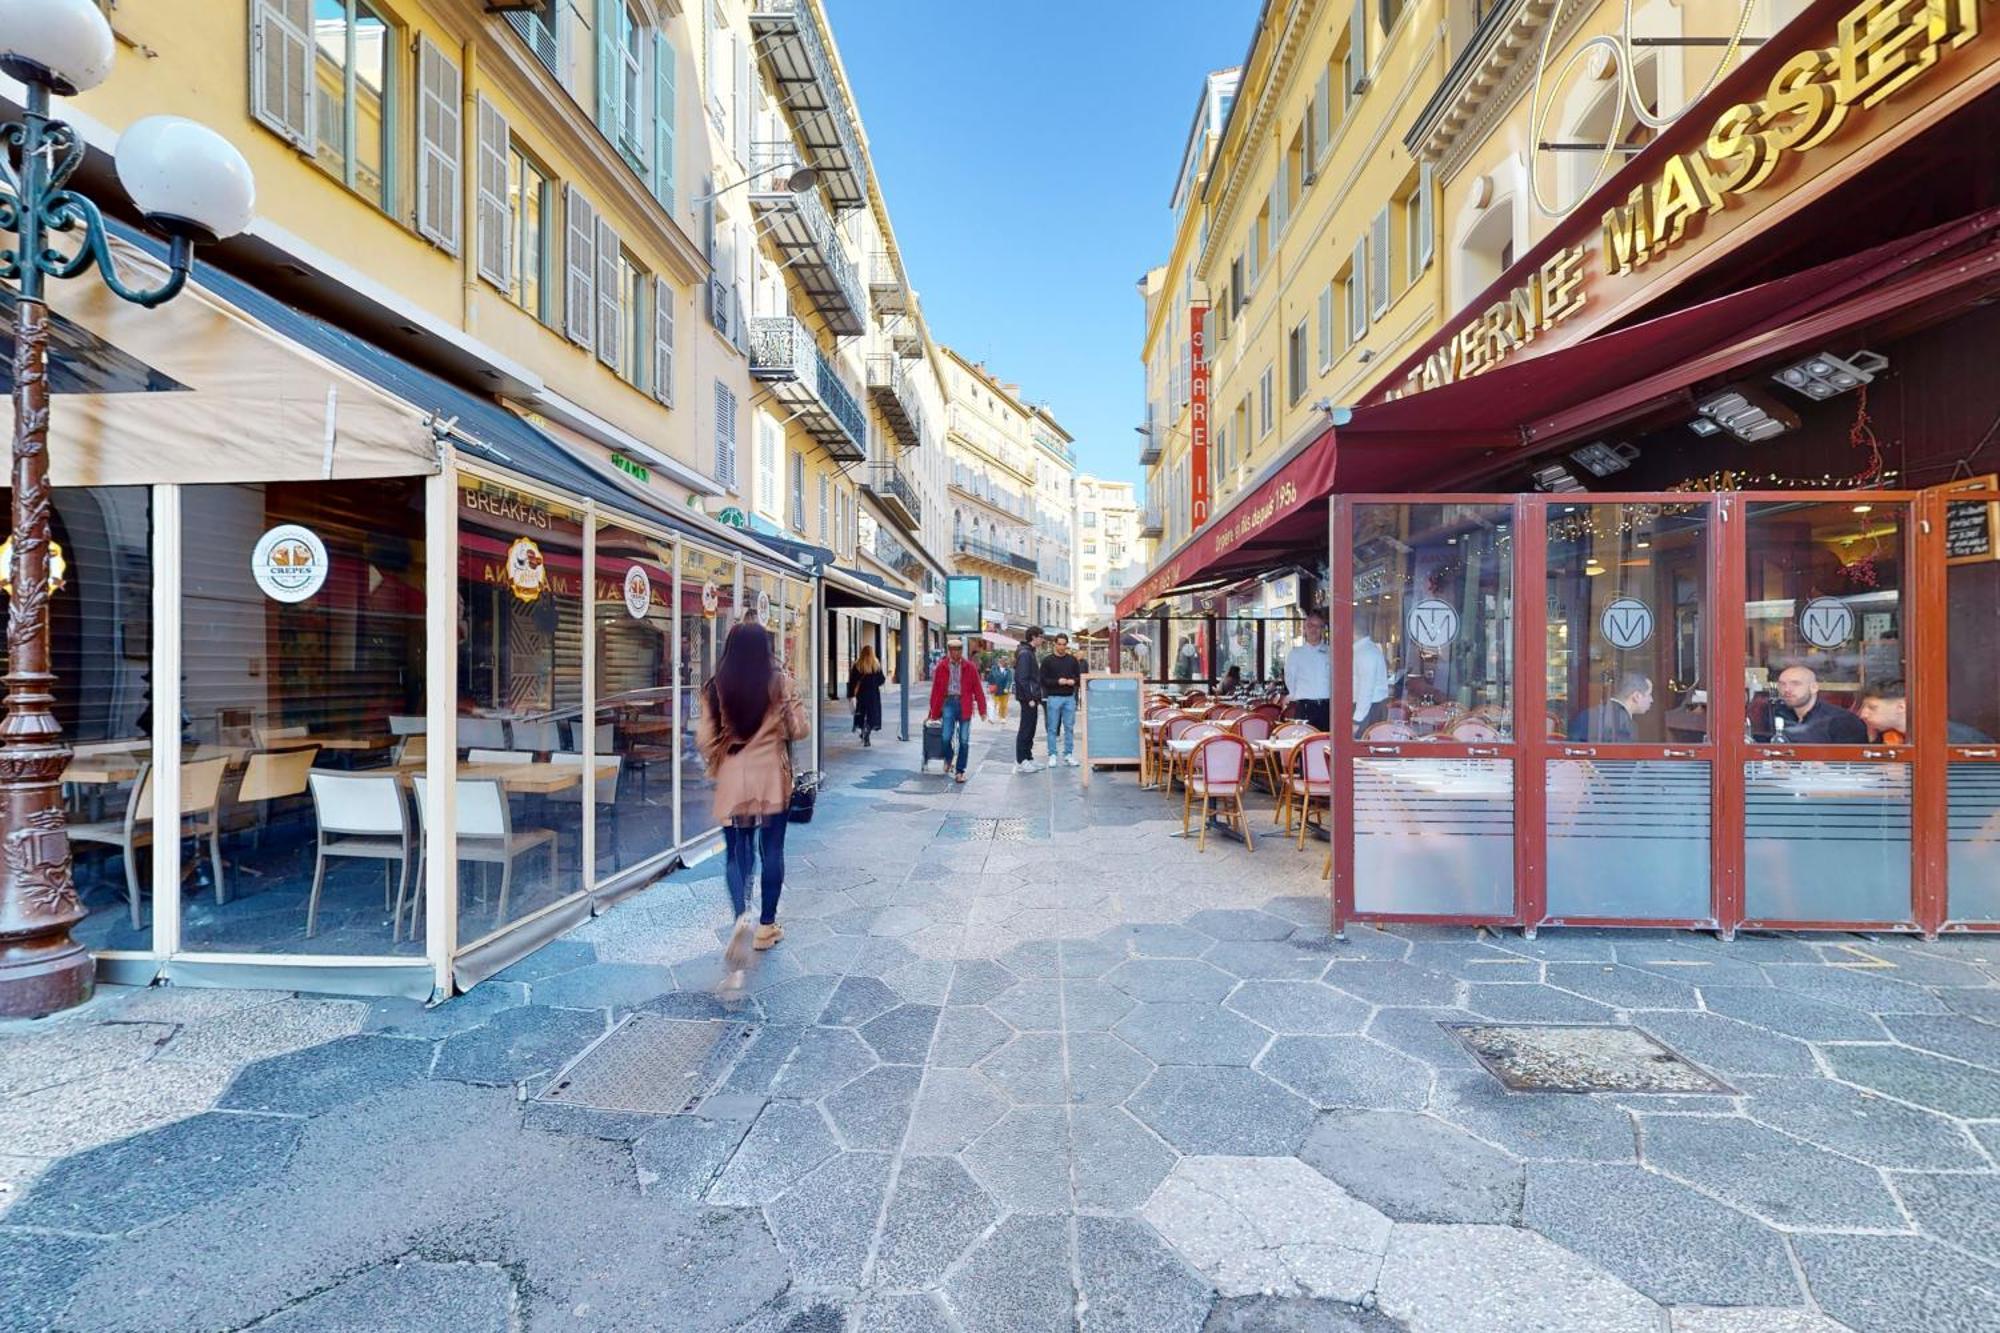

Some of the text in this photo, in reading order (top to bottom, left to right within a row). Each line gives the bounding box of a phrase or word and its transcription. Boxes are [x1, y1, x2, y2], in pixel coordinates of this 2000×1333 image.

[1407, 245, 1588, 392] TAVERNE
[466, 488, 553, 531] BREAKFAST
[1275, 480, 1297, 510] 1956
